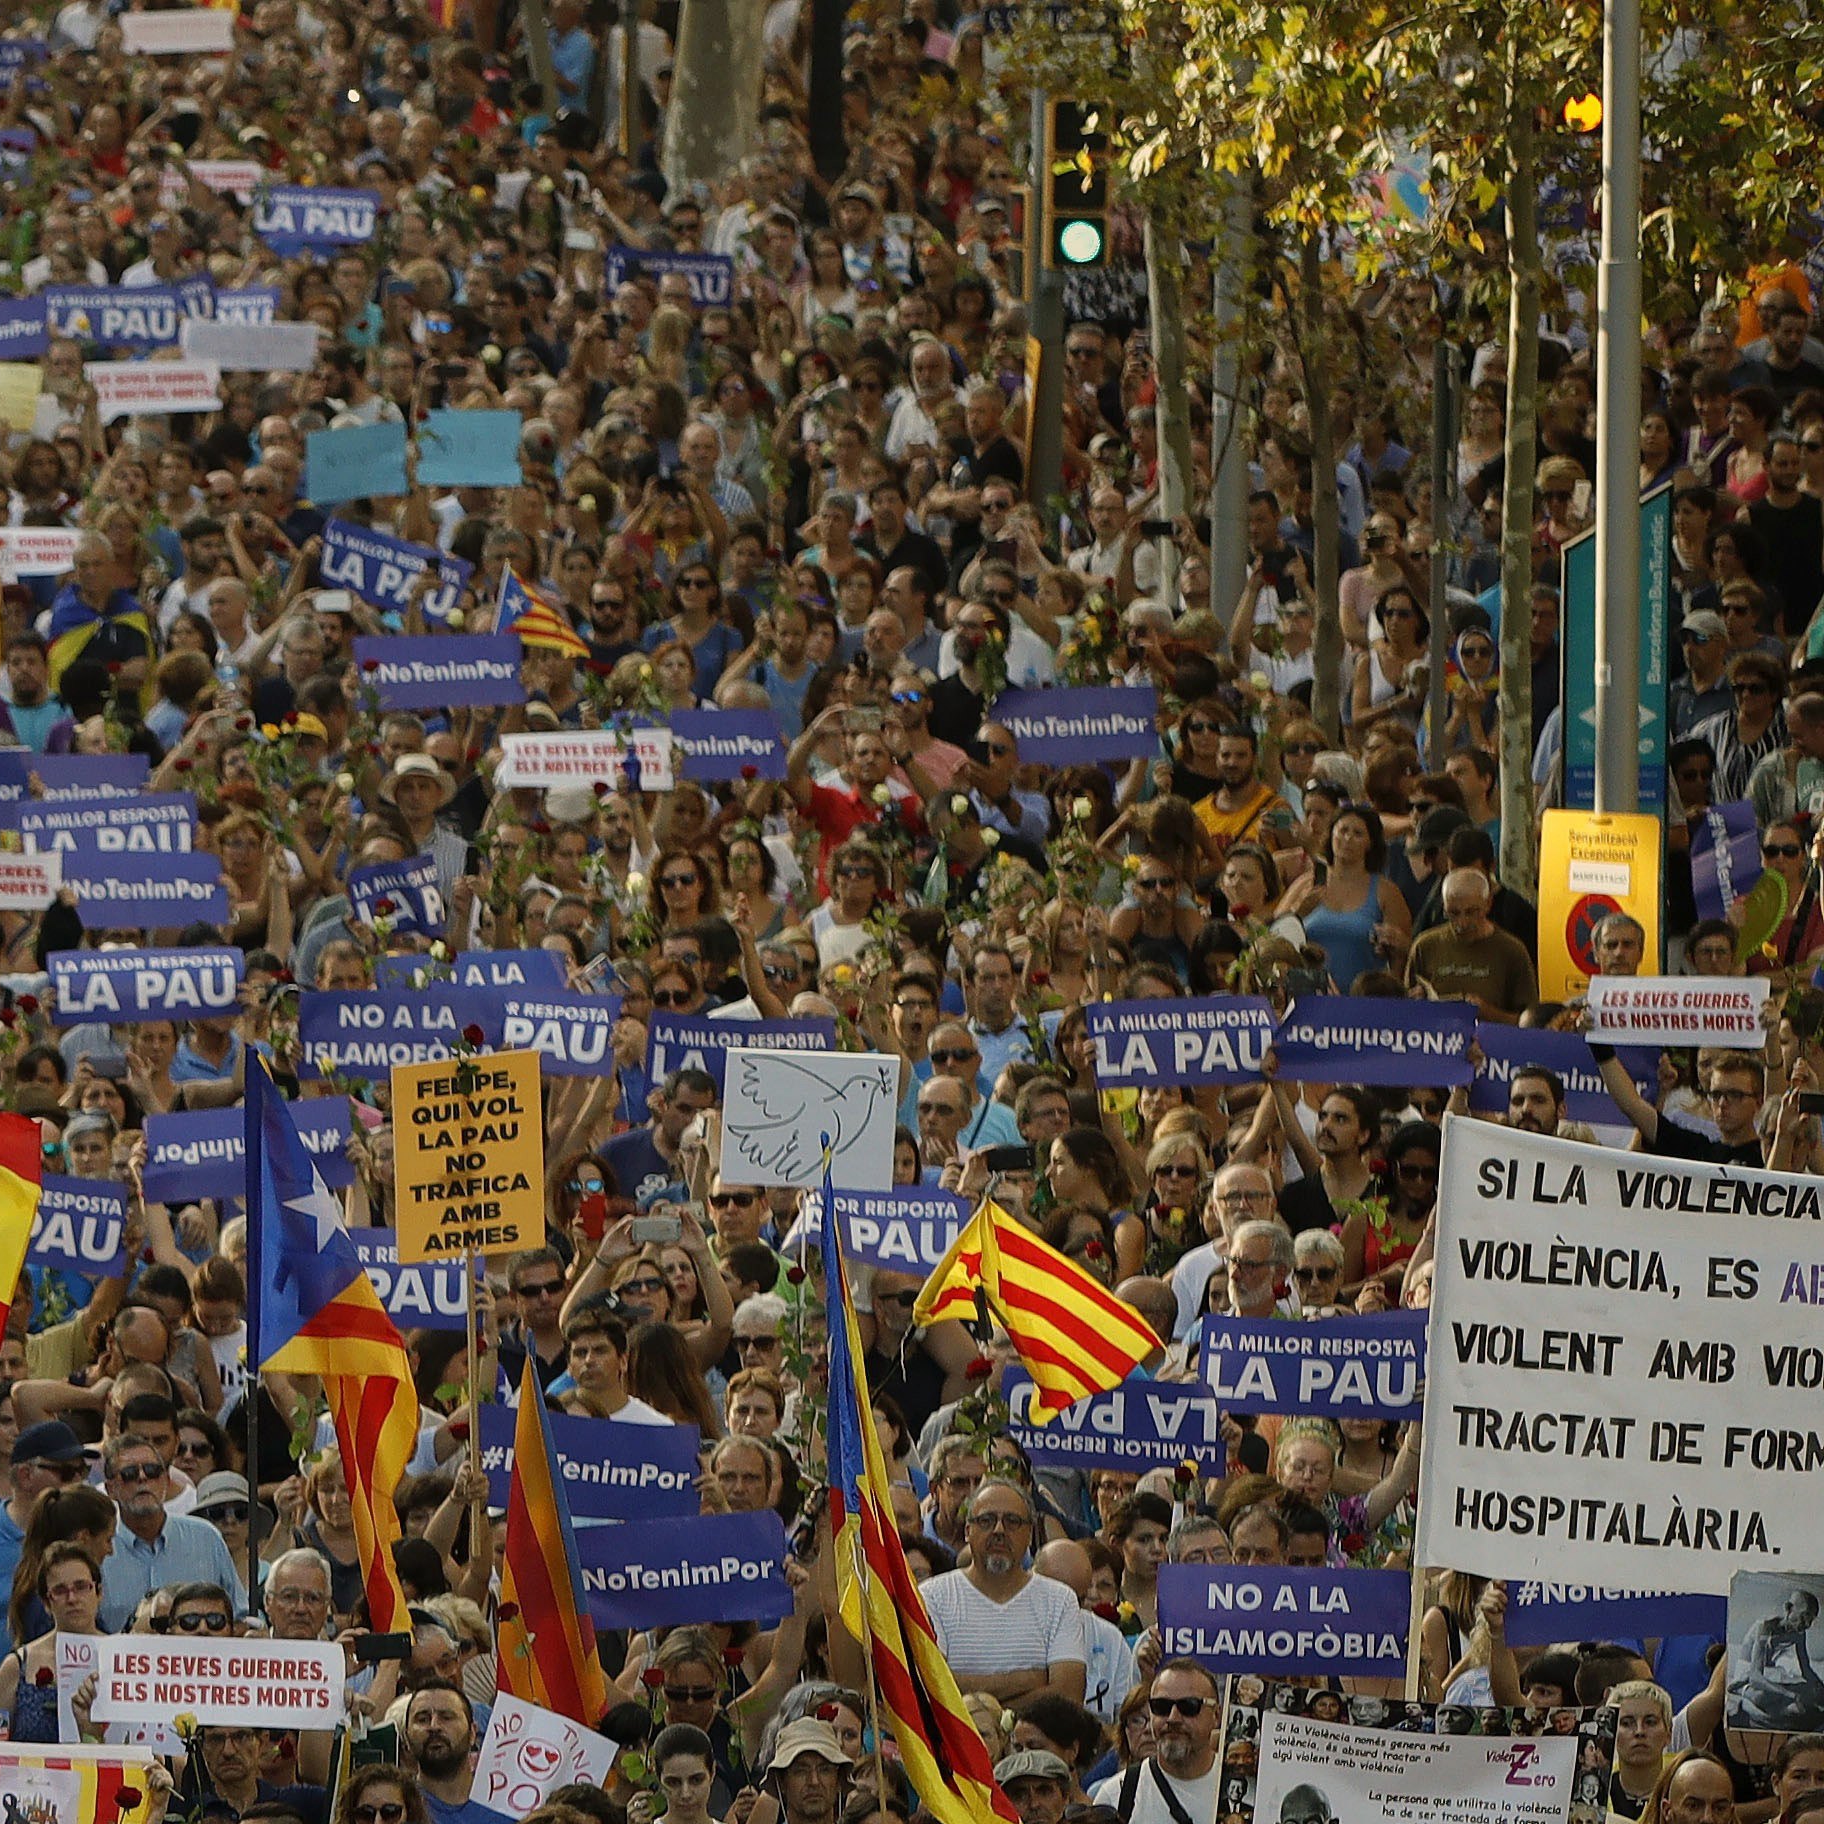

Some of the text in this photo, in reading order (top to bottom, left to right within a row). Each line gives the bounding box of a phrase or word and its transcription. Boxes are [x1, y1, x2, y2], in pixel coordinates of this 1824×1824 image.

[255, 206, 376, 239] LA PAU
[1602, 991, 1754, 1012] LES SEVES GUERRES,
[1600, 1011, 1755, 1031] ELS NOSTRES MORTS
[465, 1097, 525, 1122] VOL
[417, 1120, 520, 1152] LA PAU
[445, 1152, 488, 1176] NO
[408, 1170, 532, 1202] TRAFICA
[1477, 1158, 1822, 1220] SI LA VIOLÈNCIA
[440, 1200, 504, 1227] AMB
[422, 1224, 522, 1255] ARMES
[1458, 1234, 1760, 1299] VIOLÈNCIA, ES
[1452, 1322, 1736, 1383] VIOLENT AMB
[1453, 1405, 1705, 1464] TRACTAT DE
[1454, 1486, 1782, 1555] HOSPITALÀRIA.
[1206, 1583, 1351, 1614] NO A LA
[1165, 1625, 1403, 1660] ISLAMOFÒBIA
[1369, 1791, 1381, 1802] La
[1386, 1794, 1428, 1807] persona
[1434, 1798, 1452, 1809] que
[1400, 1807, 1413, 1818] de
[1418, 1811, 1436, 1820] ser
[1441, 1812, 1489, 1824] tractada
